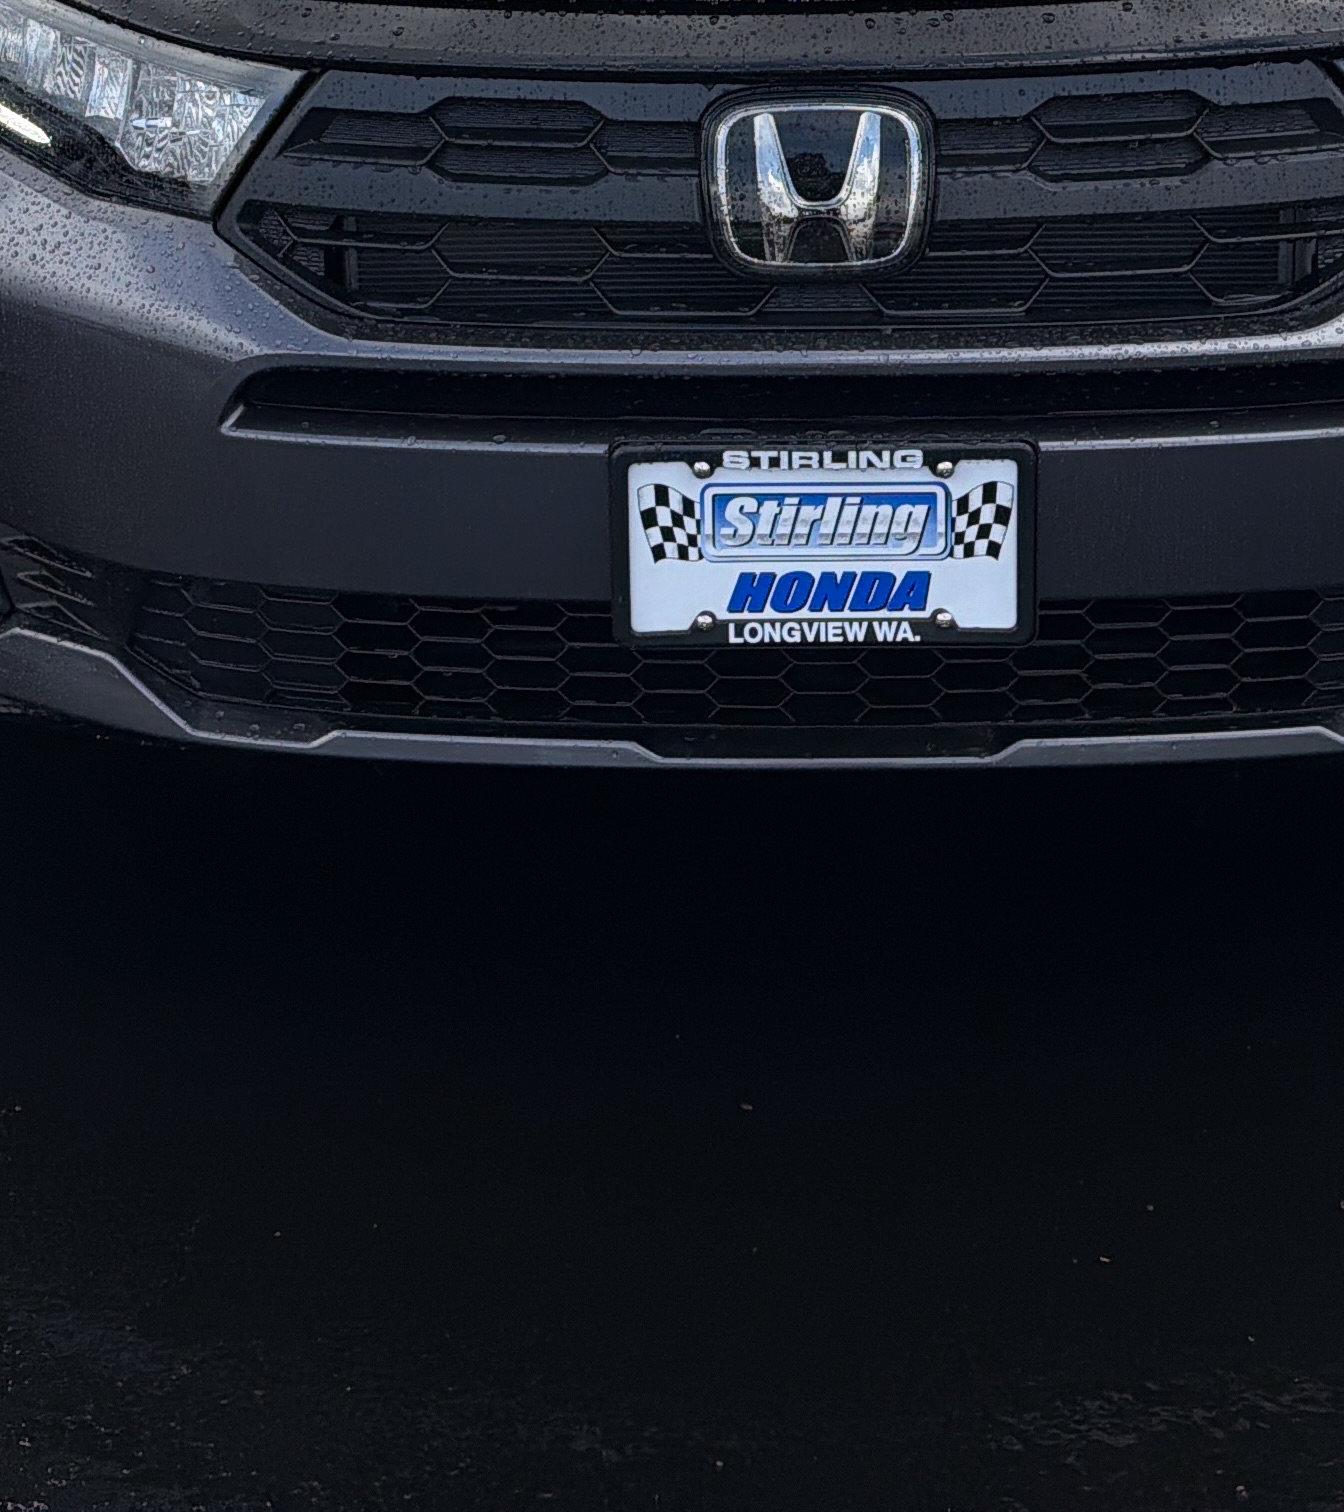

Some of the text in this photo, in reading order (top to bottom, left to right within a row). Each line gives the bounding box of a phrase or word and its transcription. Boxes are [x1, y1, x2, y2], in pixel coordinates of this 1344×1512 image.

[723, 449, 924, 470] STIRLING
[719, 496, 931, 556] Stirling
[727, 571, 931, 613] HONDA
[728, 622, 921, 644] LONGVIEW WA.
